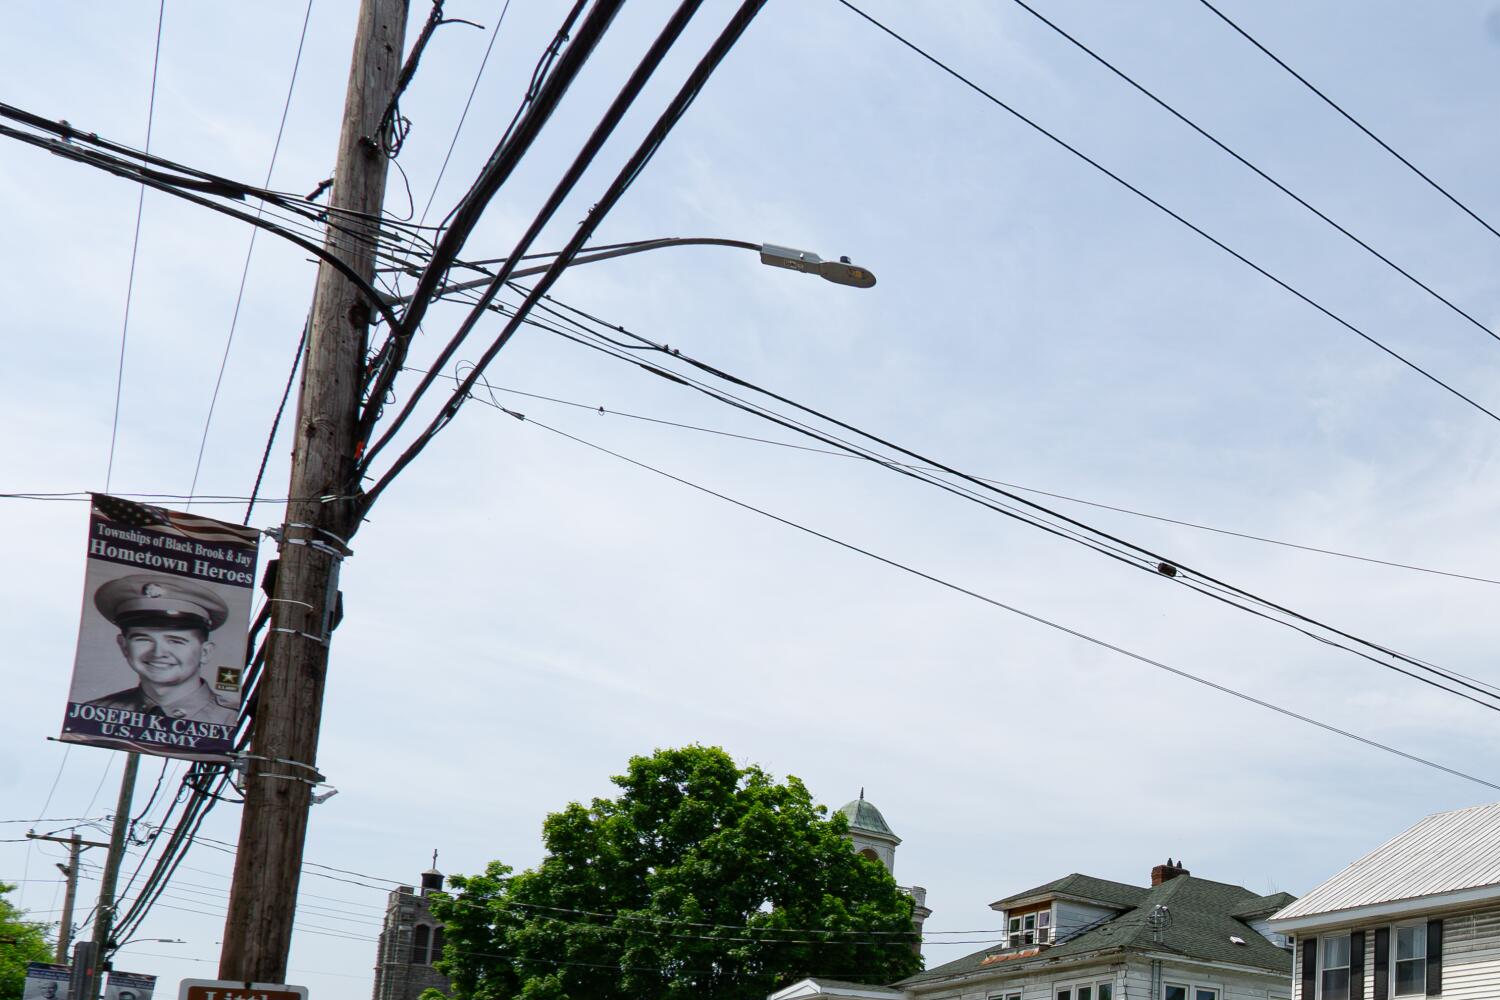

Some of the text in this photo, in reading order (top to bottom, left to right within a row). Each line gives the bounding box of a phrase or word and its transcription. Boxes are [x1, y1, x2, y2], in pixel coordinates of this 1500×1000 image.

[90, 538, 253, 584] Hometown Heroes
[97, 522, 252, 567] Townships of Black Brook & Jay
[69, 704, 235, 741] JOSEPH K. CASEY
[101, 723, 201, 748] U.S. ARMY
